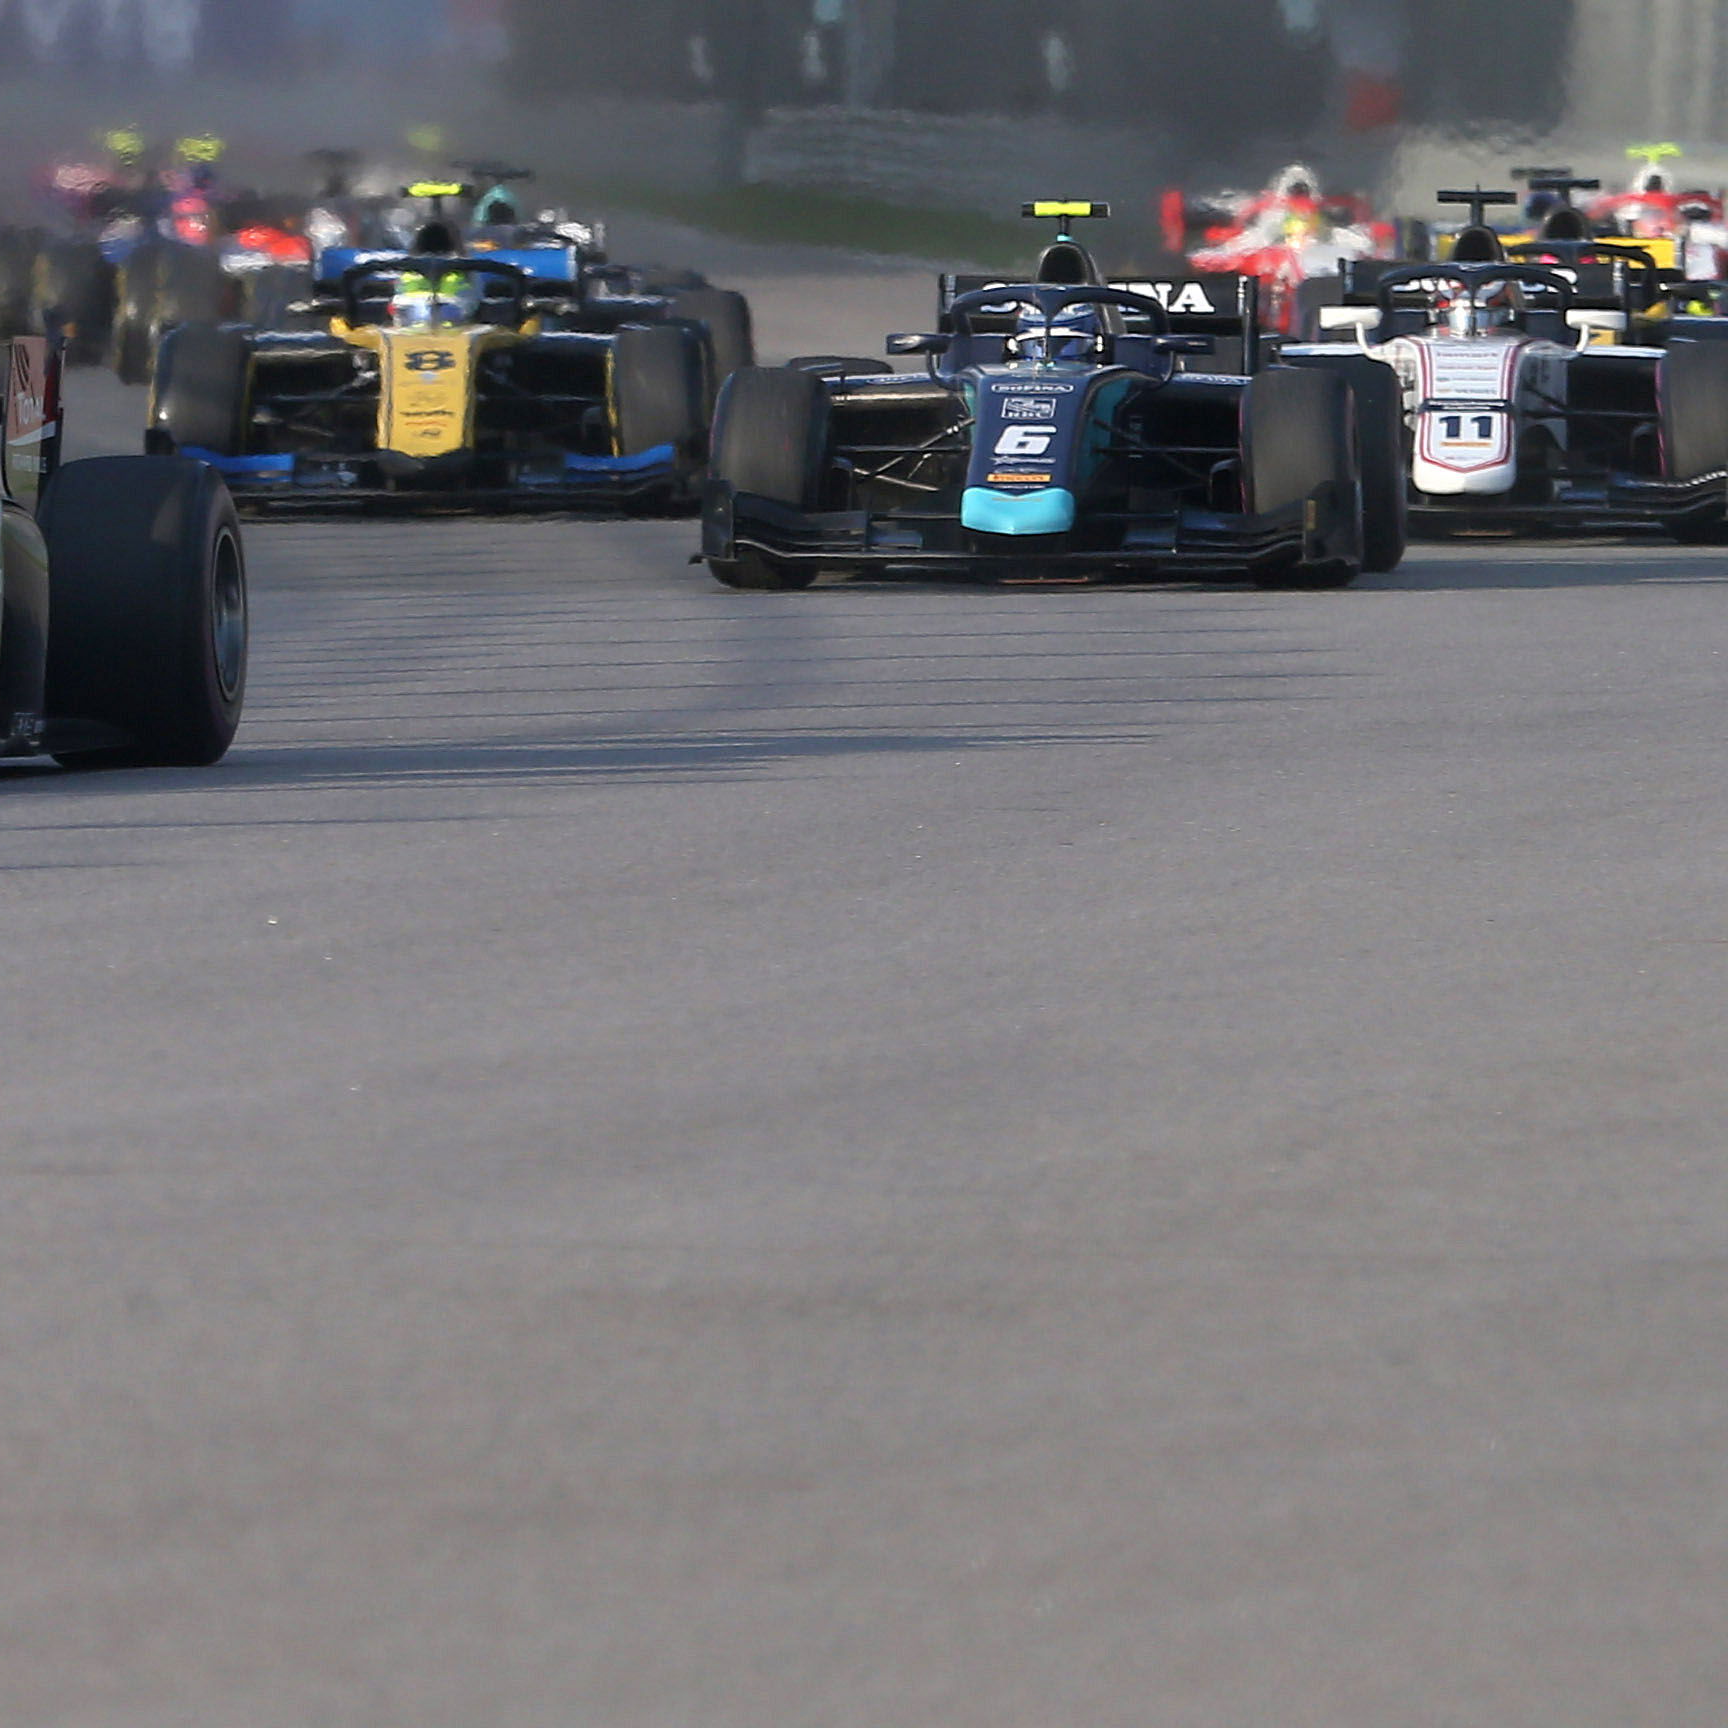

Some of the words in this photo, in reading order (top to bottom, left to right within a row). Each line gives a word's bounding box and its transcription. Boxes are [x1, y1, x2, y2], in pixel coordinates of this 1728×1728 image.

[404, 350, 456, 371] 8
[1439, 415, 1493, 439] 11
[994, 425, 1057, 455] 6
